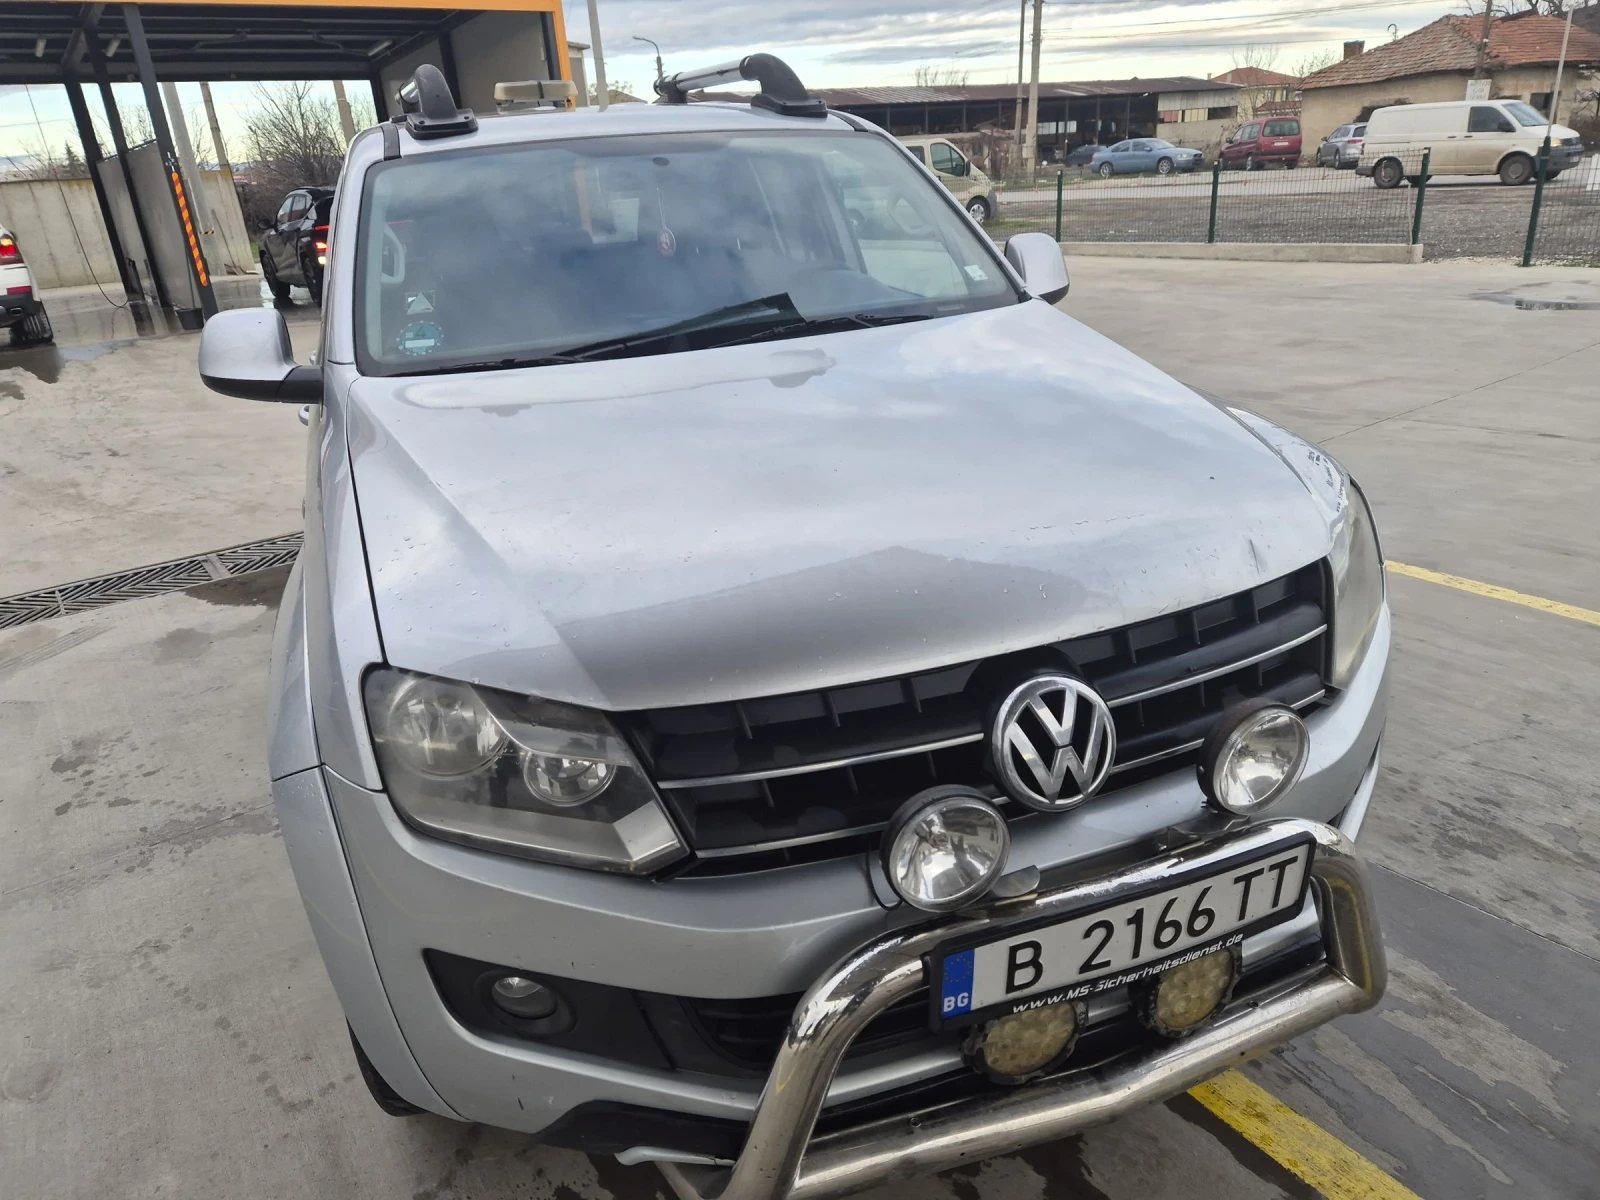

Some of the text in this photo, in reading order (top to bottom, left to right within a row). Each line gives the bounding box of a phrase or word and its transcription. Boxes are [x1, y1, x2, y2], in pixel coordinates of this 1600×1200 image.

[1005, 855, 1299, 995] B 2166 TT
[943, 992, 970, 1013] BG
[1012, 932, 1245, 1014] www.MS-Sicherheitsdienst.de
